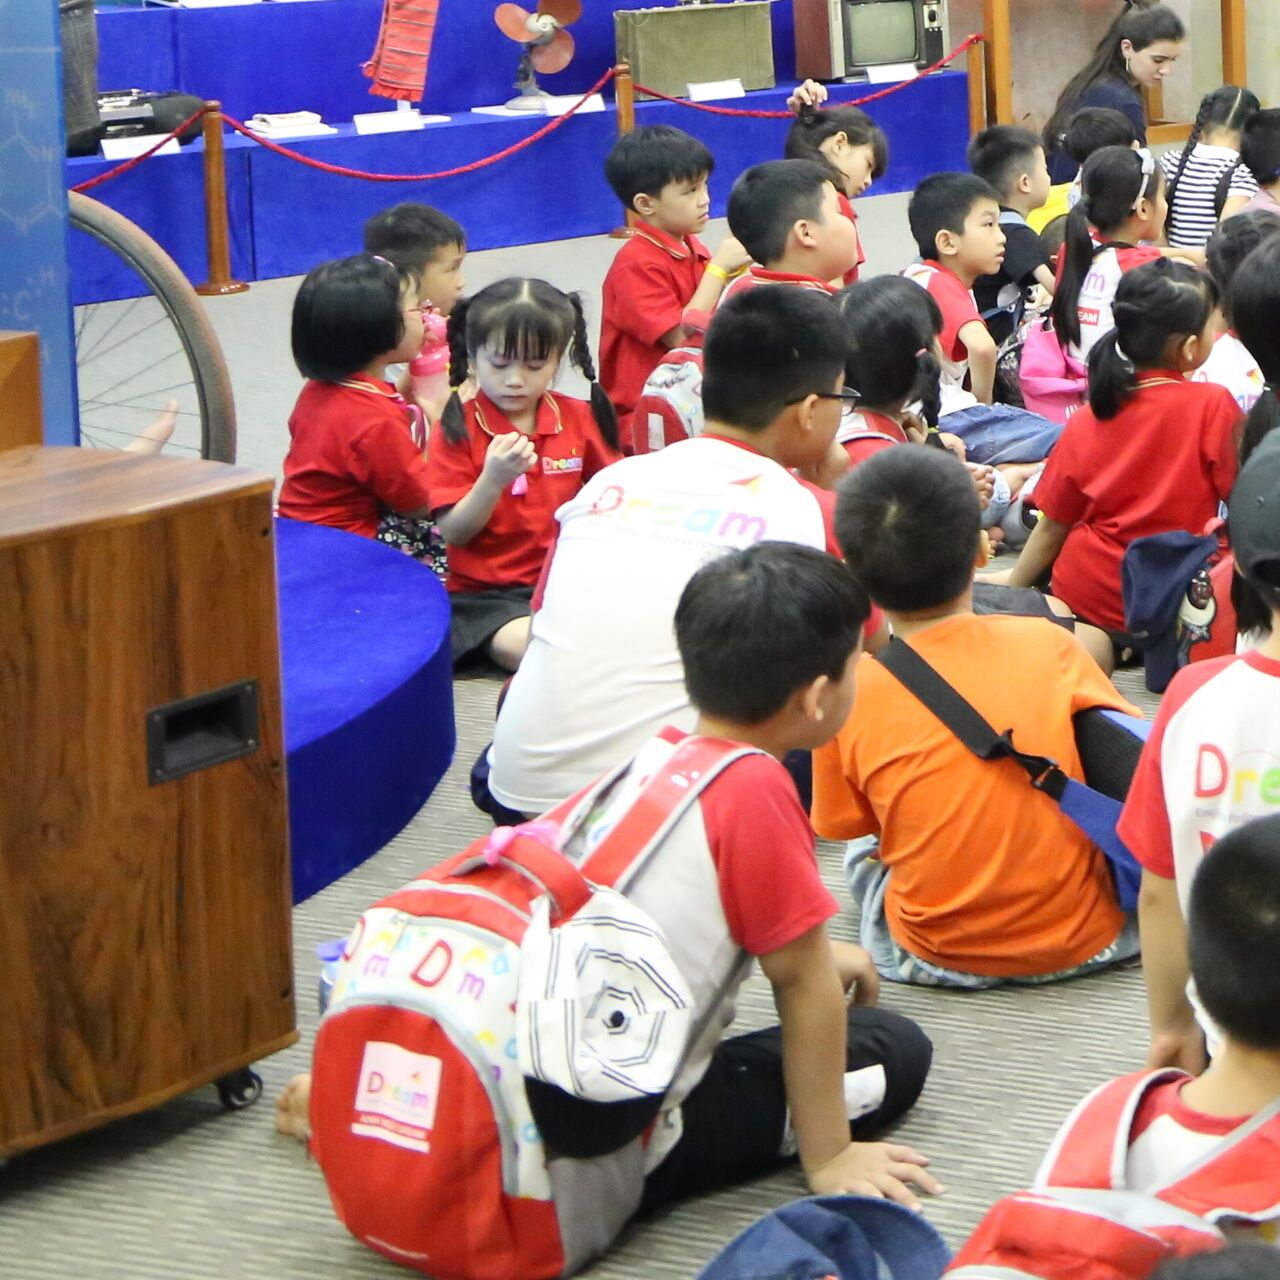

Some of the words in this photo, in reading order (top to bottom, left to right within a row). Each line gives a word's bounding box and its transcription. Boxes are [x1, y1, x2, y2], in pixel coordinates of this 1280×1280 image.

[1078, 310, 1098, 324] EAM
[542, 457, 583, 470] Dream
[367, 1072, 429, 1109] Dream
